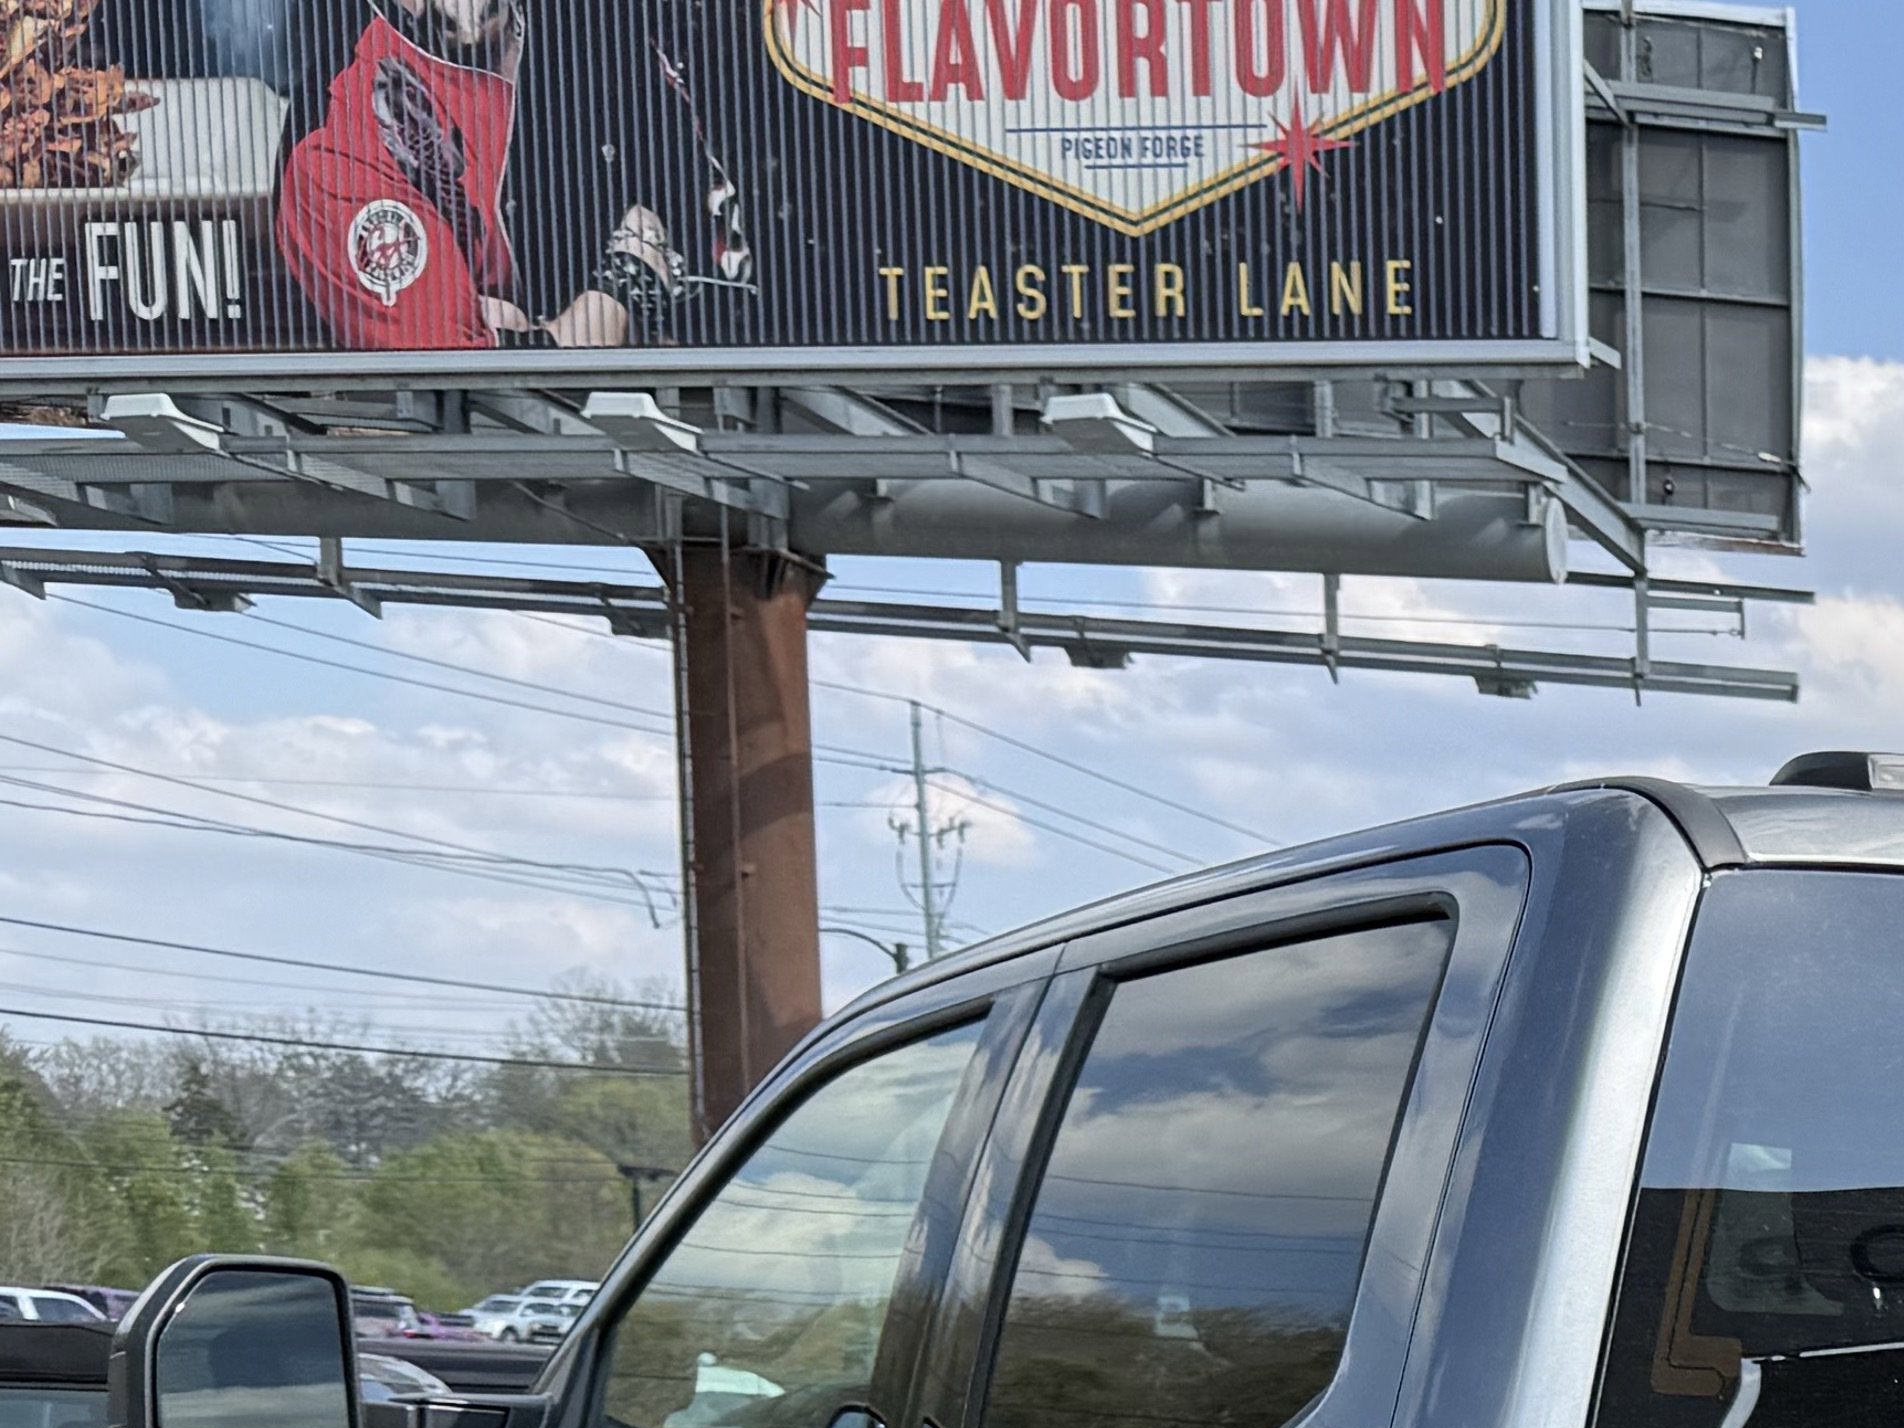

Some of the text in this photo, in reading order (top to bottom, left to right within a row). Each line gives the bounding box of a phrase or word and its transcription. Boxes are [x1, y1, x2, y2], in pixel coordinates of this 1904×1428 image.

[830, 0, 1448, 104] FLAVORTOWN
[1060, 134, 1205, 161] PIGEON FORGE
[9, 219, 242, 321] THE FUN!
[878, 259, 1413, 321] TEASTER LANE
